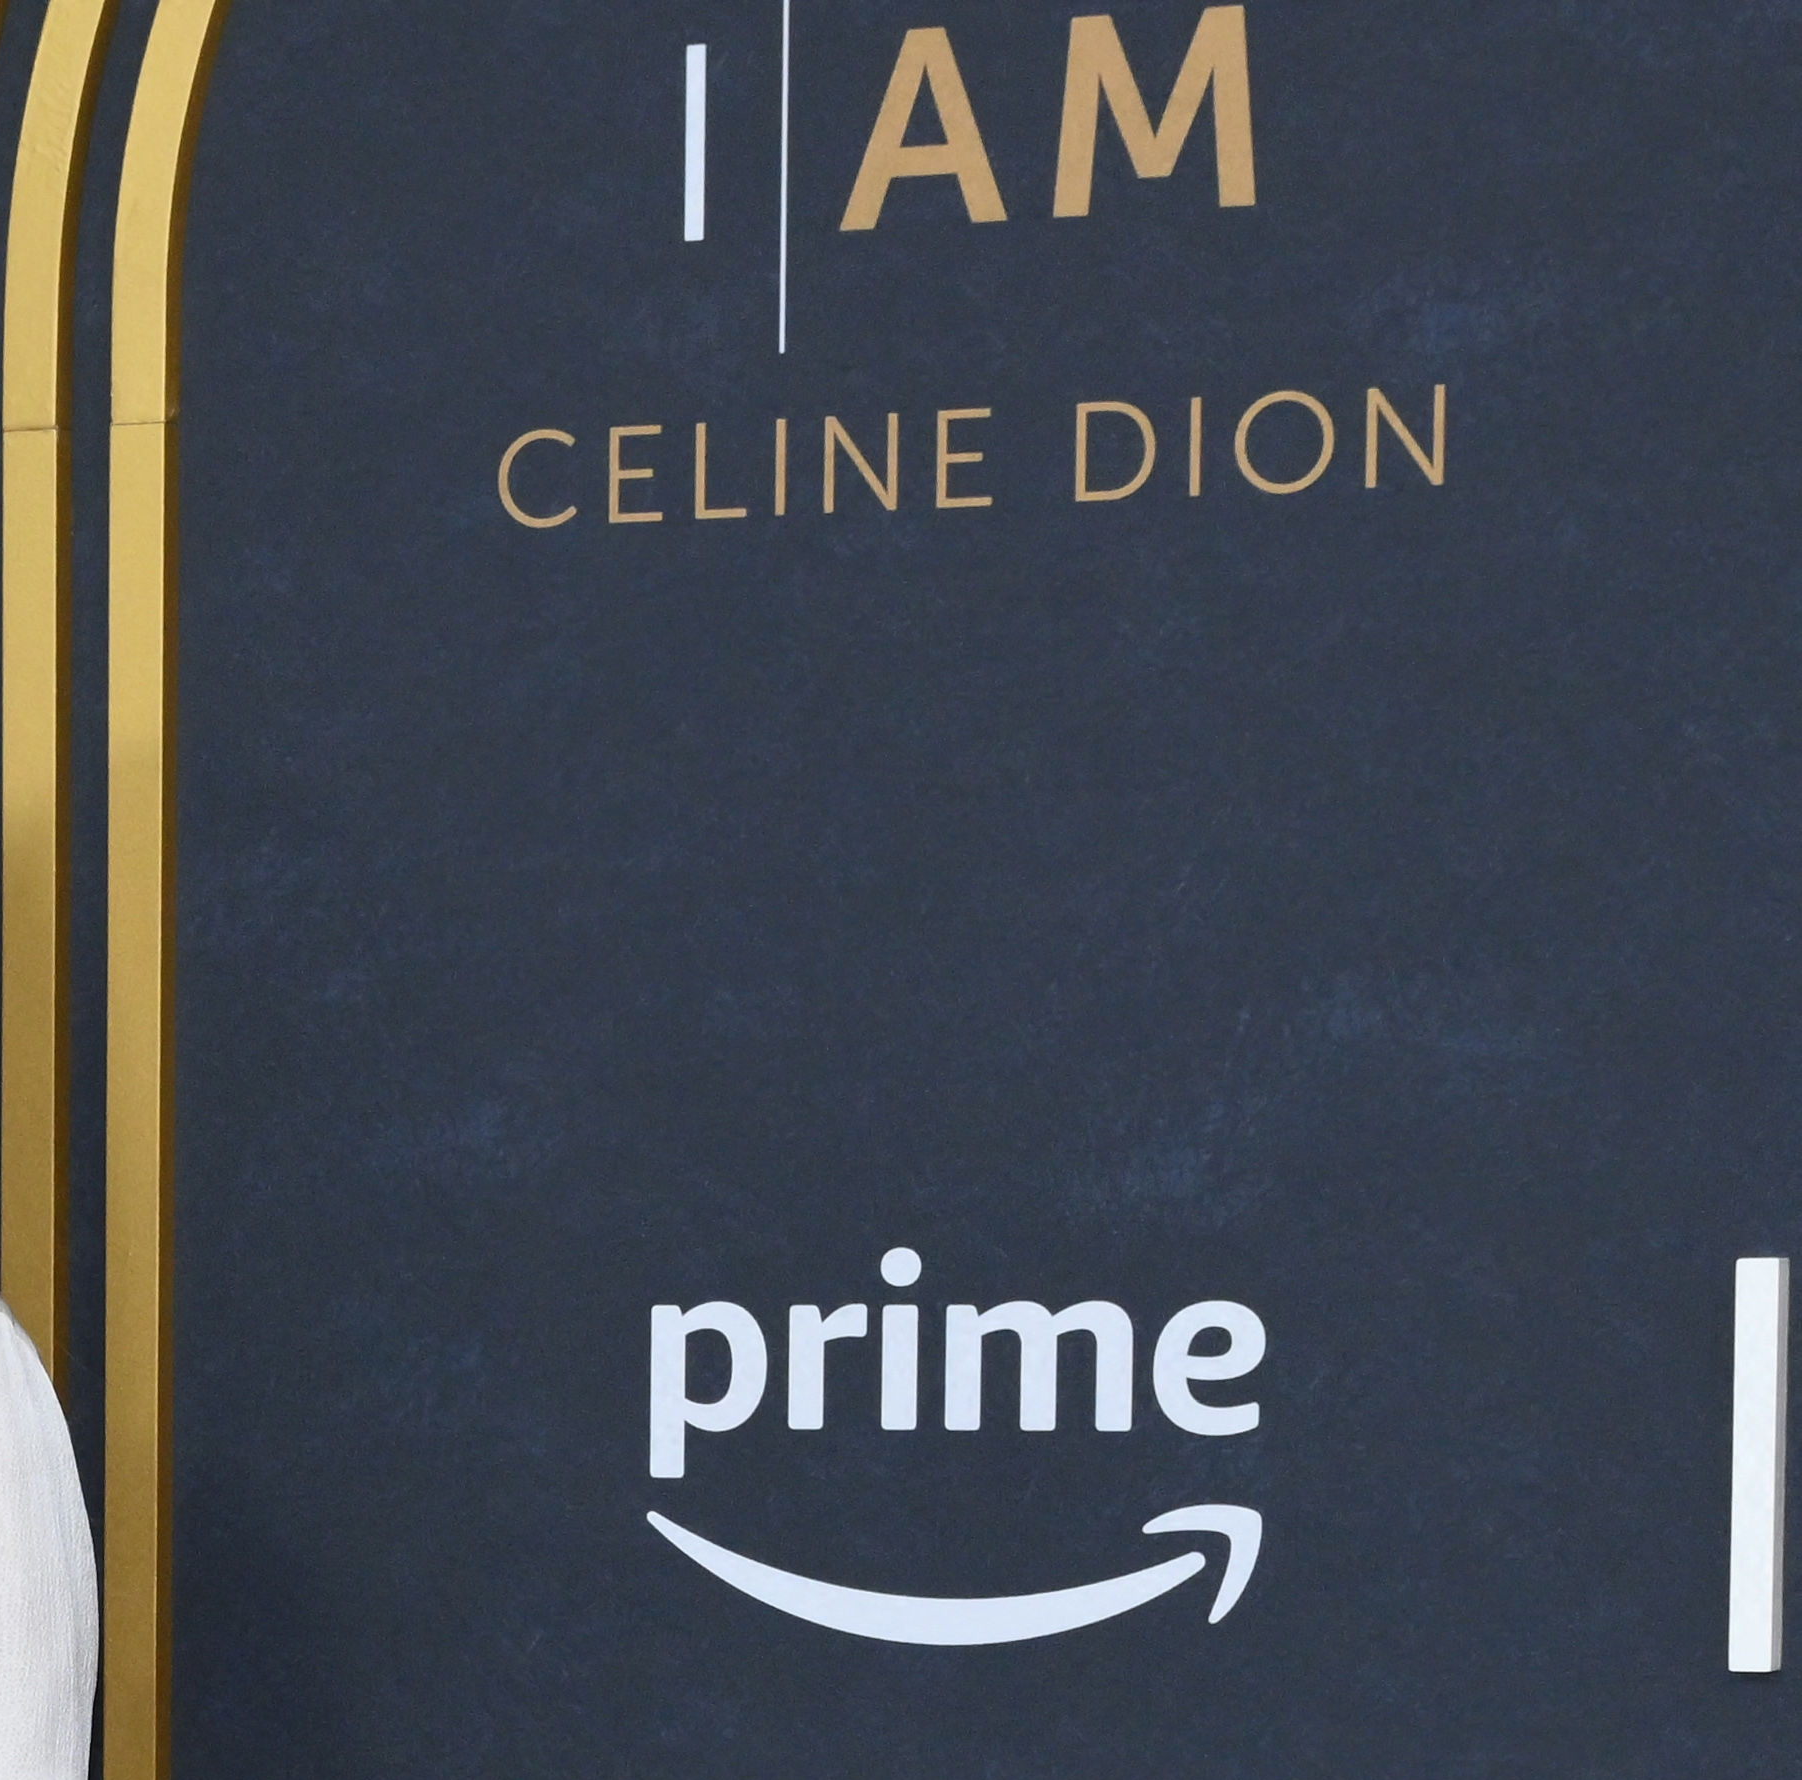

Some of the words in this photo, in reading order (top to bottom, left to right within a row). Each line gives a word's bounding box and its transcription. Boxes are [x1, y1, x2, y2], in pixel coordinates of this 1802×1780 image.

[839, 5, 1256, 232] AM
[498, 407, 993, 528] CELINE
[1075, 383, 1446, 502] DION
[649, 1247, 1266, 1478] prime
